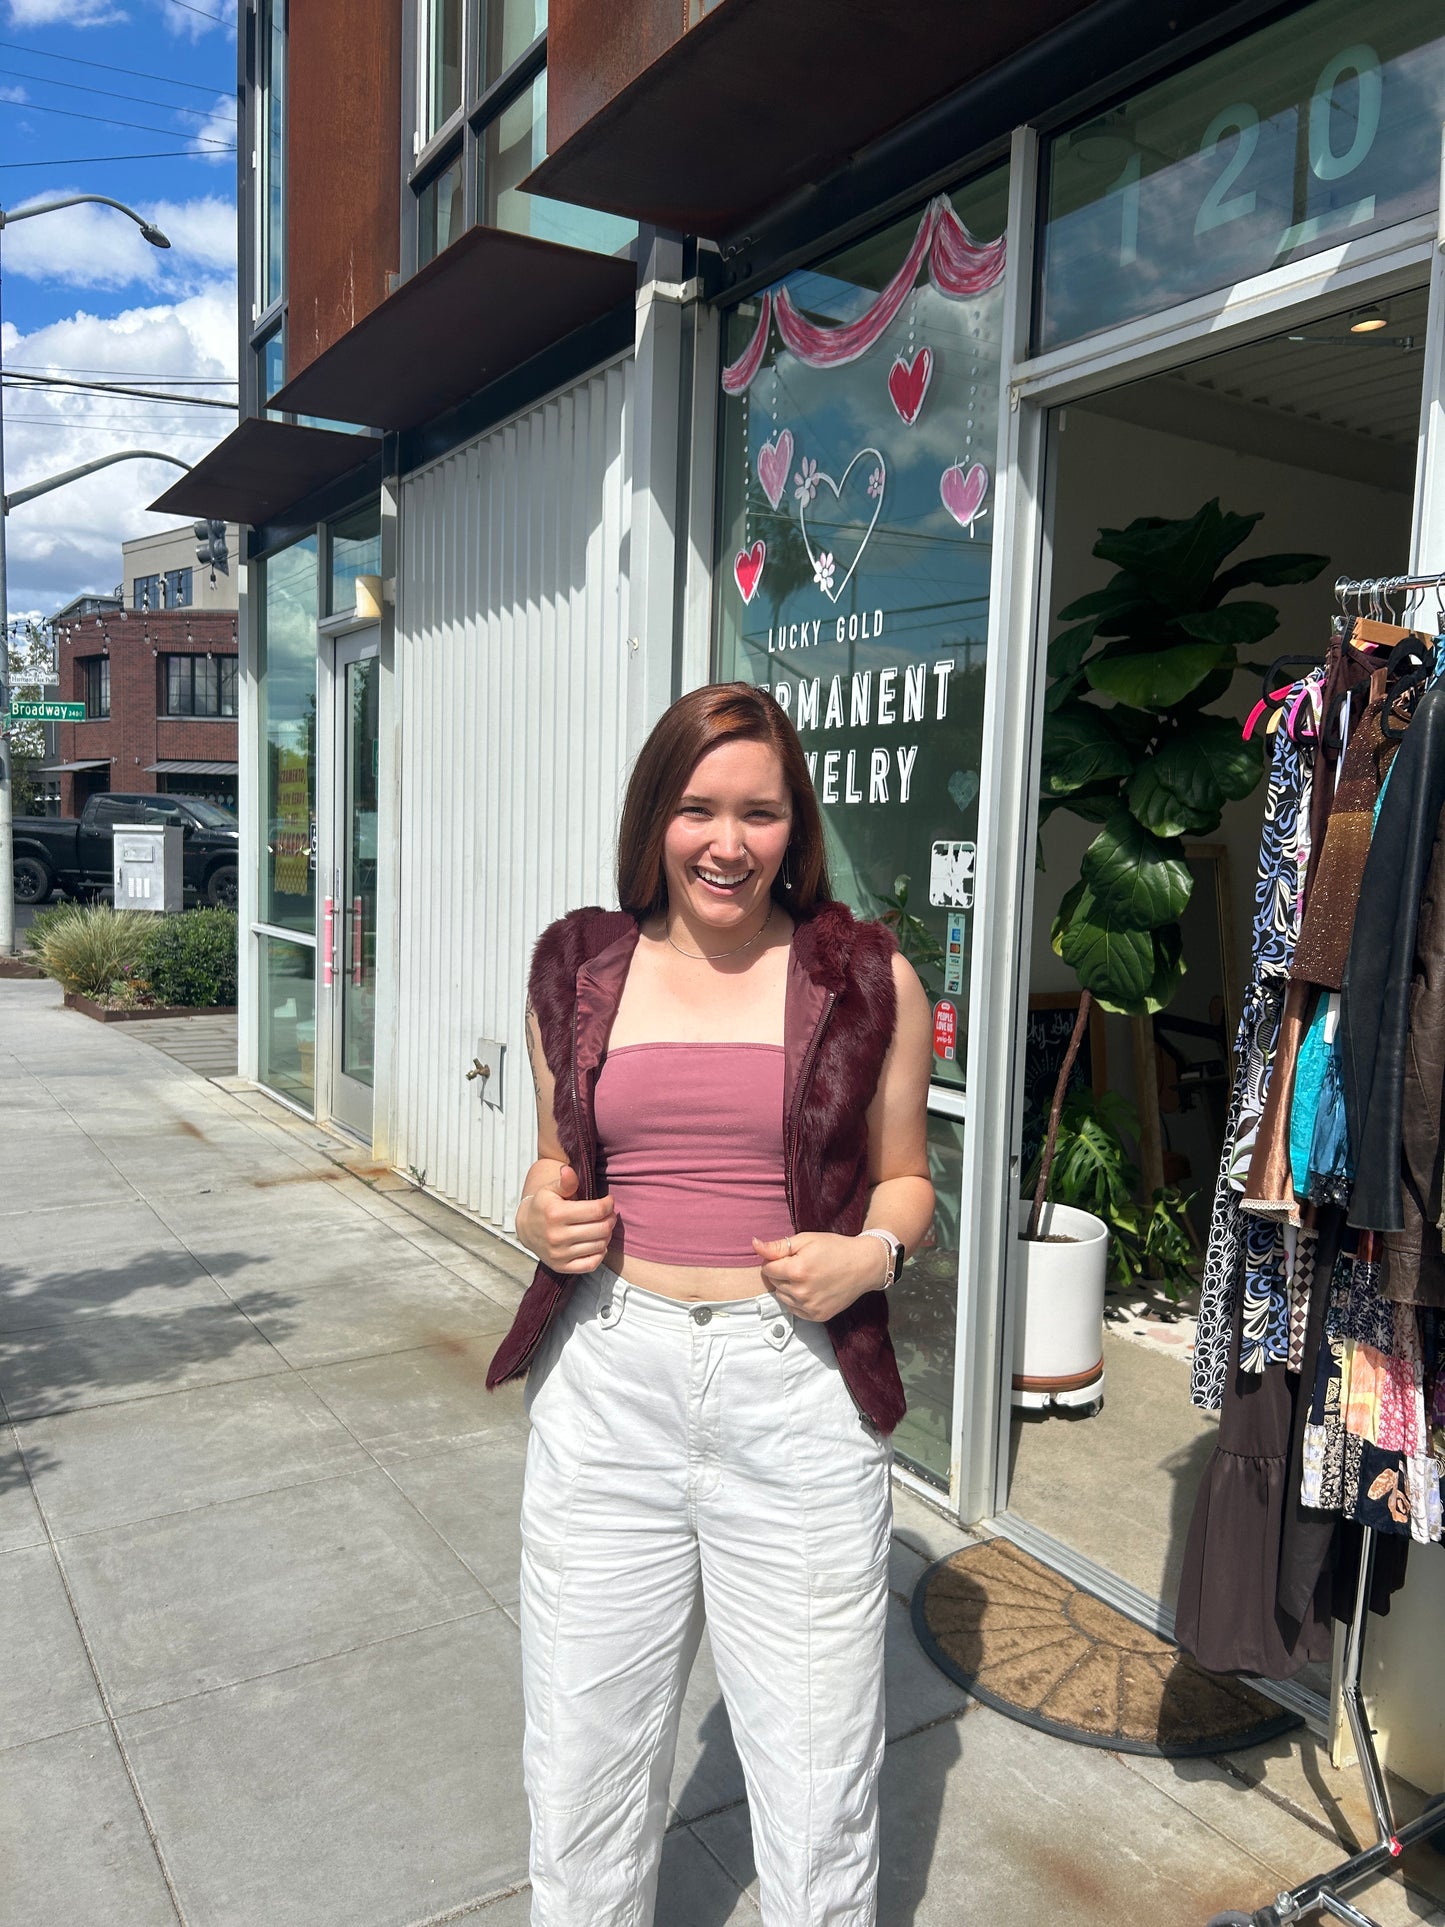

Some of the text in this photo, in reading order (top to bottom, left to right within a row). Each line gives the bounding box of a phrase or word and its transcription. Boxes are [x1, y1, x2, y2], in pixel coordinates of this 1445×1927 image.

[768, 609, 883, 653] LUCKY GOLD
[758, 660, 955, 732] RMANENT
[12, 703, 67, 719] Broadway
[937, 1011, 953, 1023] PEOPLE
[936, 1021, 953, 1033] LOVE US
